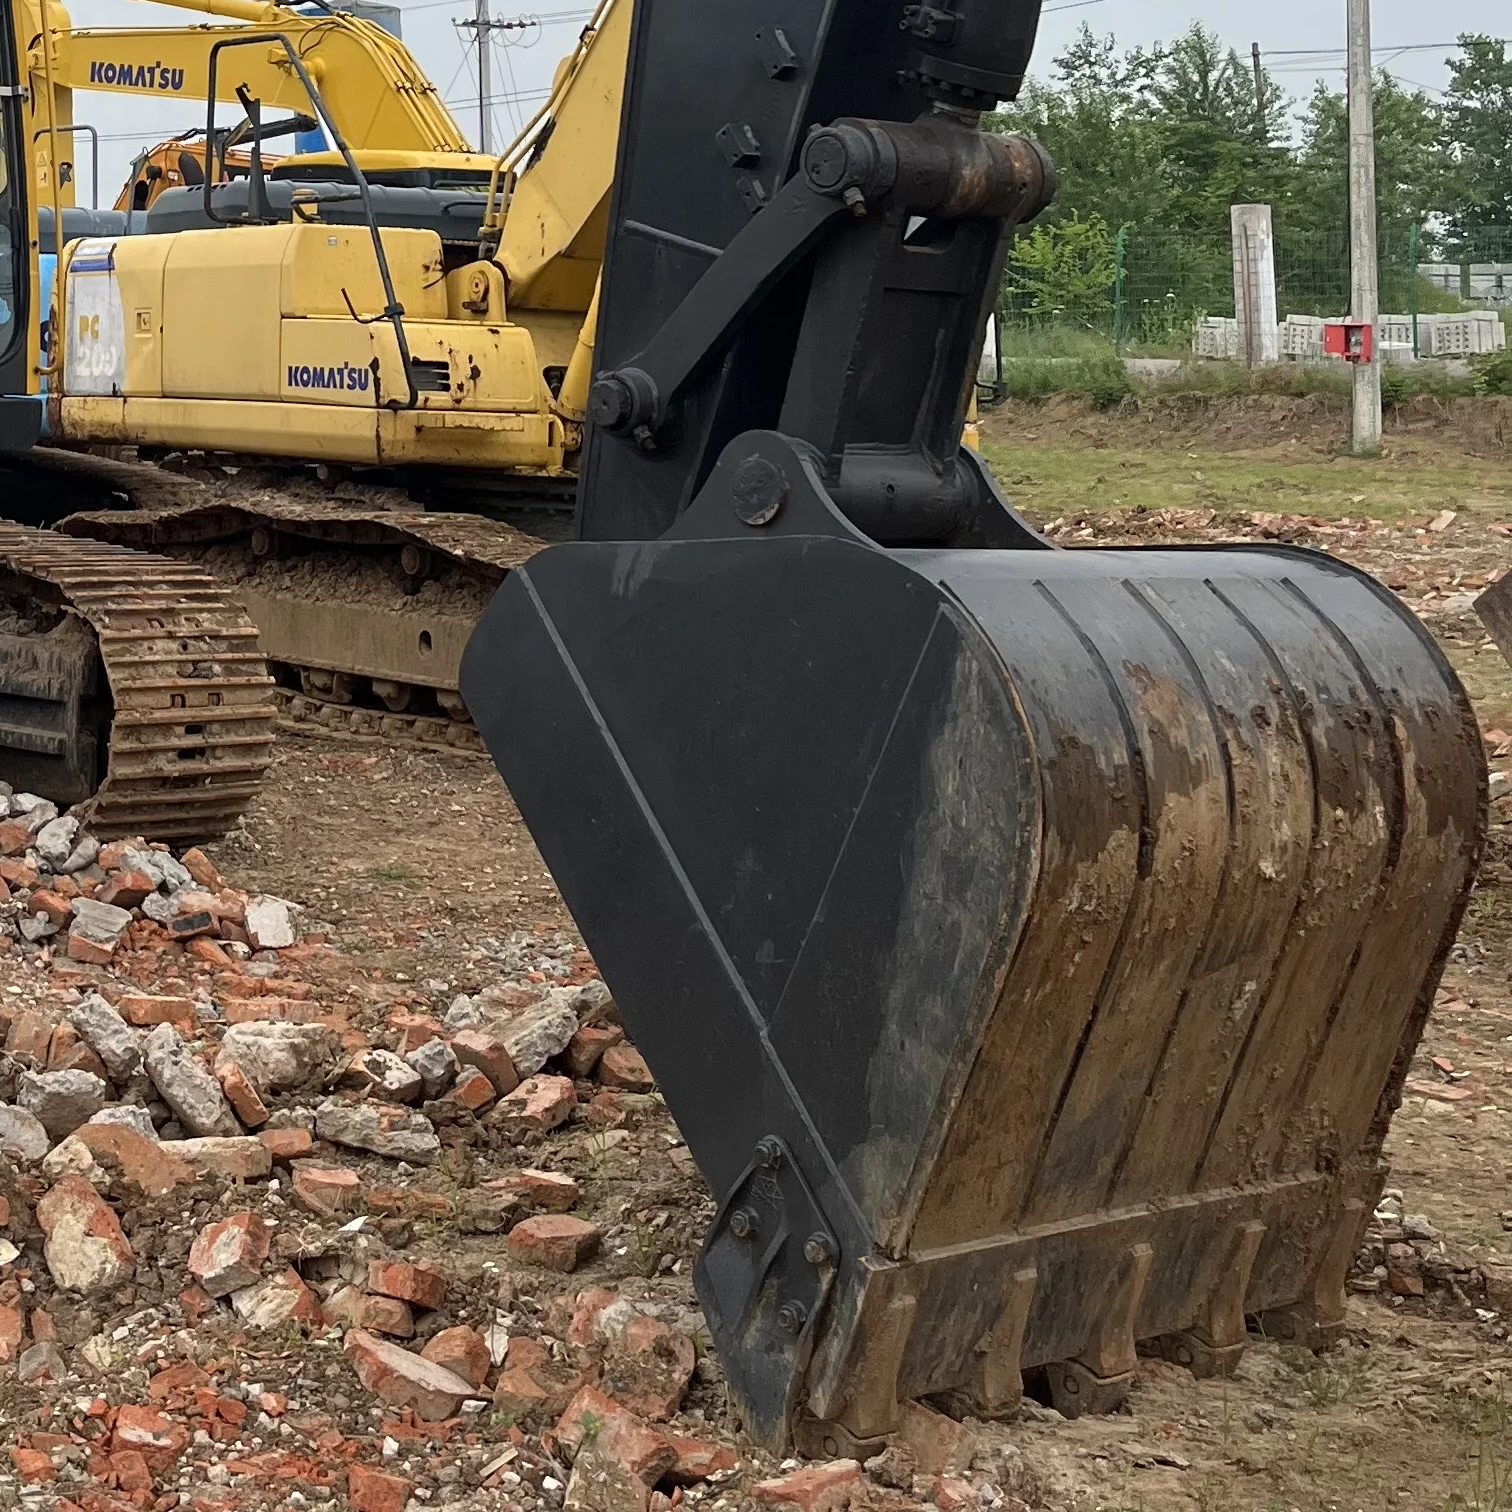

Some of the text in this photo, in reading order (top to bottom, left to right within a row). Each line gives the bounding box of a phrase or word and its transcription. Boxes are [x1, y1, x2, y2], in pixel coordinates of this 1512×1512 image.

[90, 61, 184, 90] KOMATSU
[78, 315, 100, 342] PC
[287, 361, 369, 391] KOMATSU
